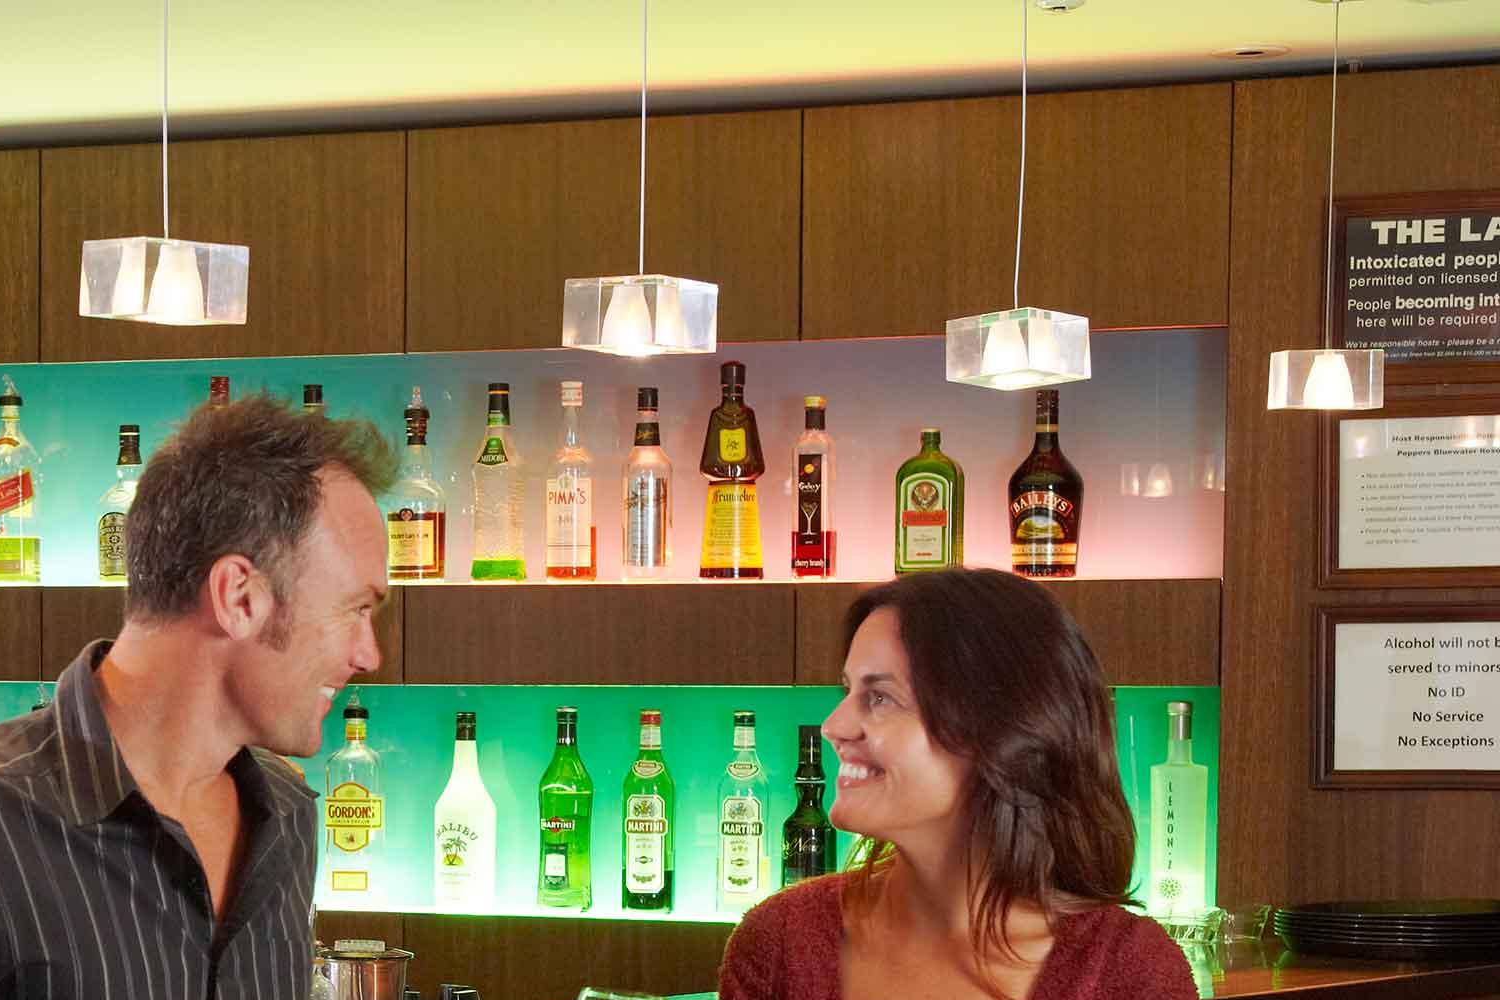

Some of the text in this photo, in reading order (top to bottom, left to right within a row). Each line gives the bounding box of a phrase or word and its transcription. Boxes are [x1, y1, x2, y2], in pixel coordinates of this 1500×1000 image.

[1371, 219, 1446, 245] THE
[1350, 253, 1446, 270] Intoxicated
[1349, 272, 1498, 288] permitted on licensed
[1348, 299, 1391, 311] People
[1395, 295, 1475, 310] becoming
[1356, 312, 1497, 328] here will be required
[1370, 339, 1417, 348] responsible
[1418, 339, 1440, 347] hosts
[1446, 338, 1475, 347] please
[1391, 435, 1412, 443] Host
[1396, 449, 1431, 457] Peppers
[1434, 448, 1477, 456] Bluewater
[712, 488, 756, 504] franelico
[1012, 493, 1068, 513] BAILEYS
[1384, 637, 1435, 649] Alcohol
[1438, 637, 1463, 648] will
[1467, 638, 1490, 648] not
[1387, 661, 1500, 673] served to minors
[1428, 686, 1466, 697] No ID
[1412, 710, 1484, 722] No Service
[1398, 735, 1494, 749] No Exceptions
[541, 820, 574, 829] MARTINI
[627, 821, 664, 832] MARTINI
[723, 823, 760, 835] MARTINI
[436, 822, 478, 841] MALIBU
